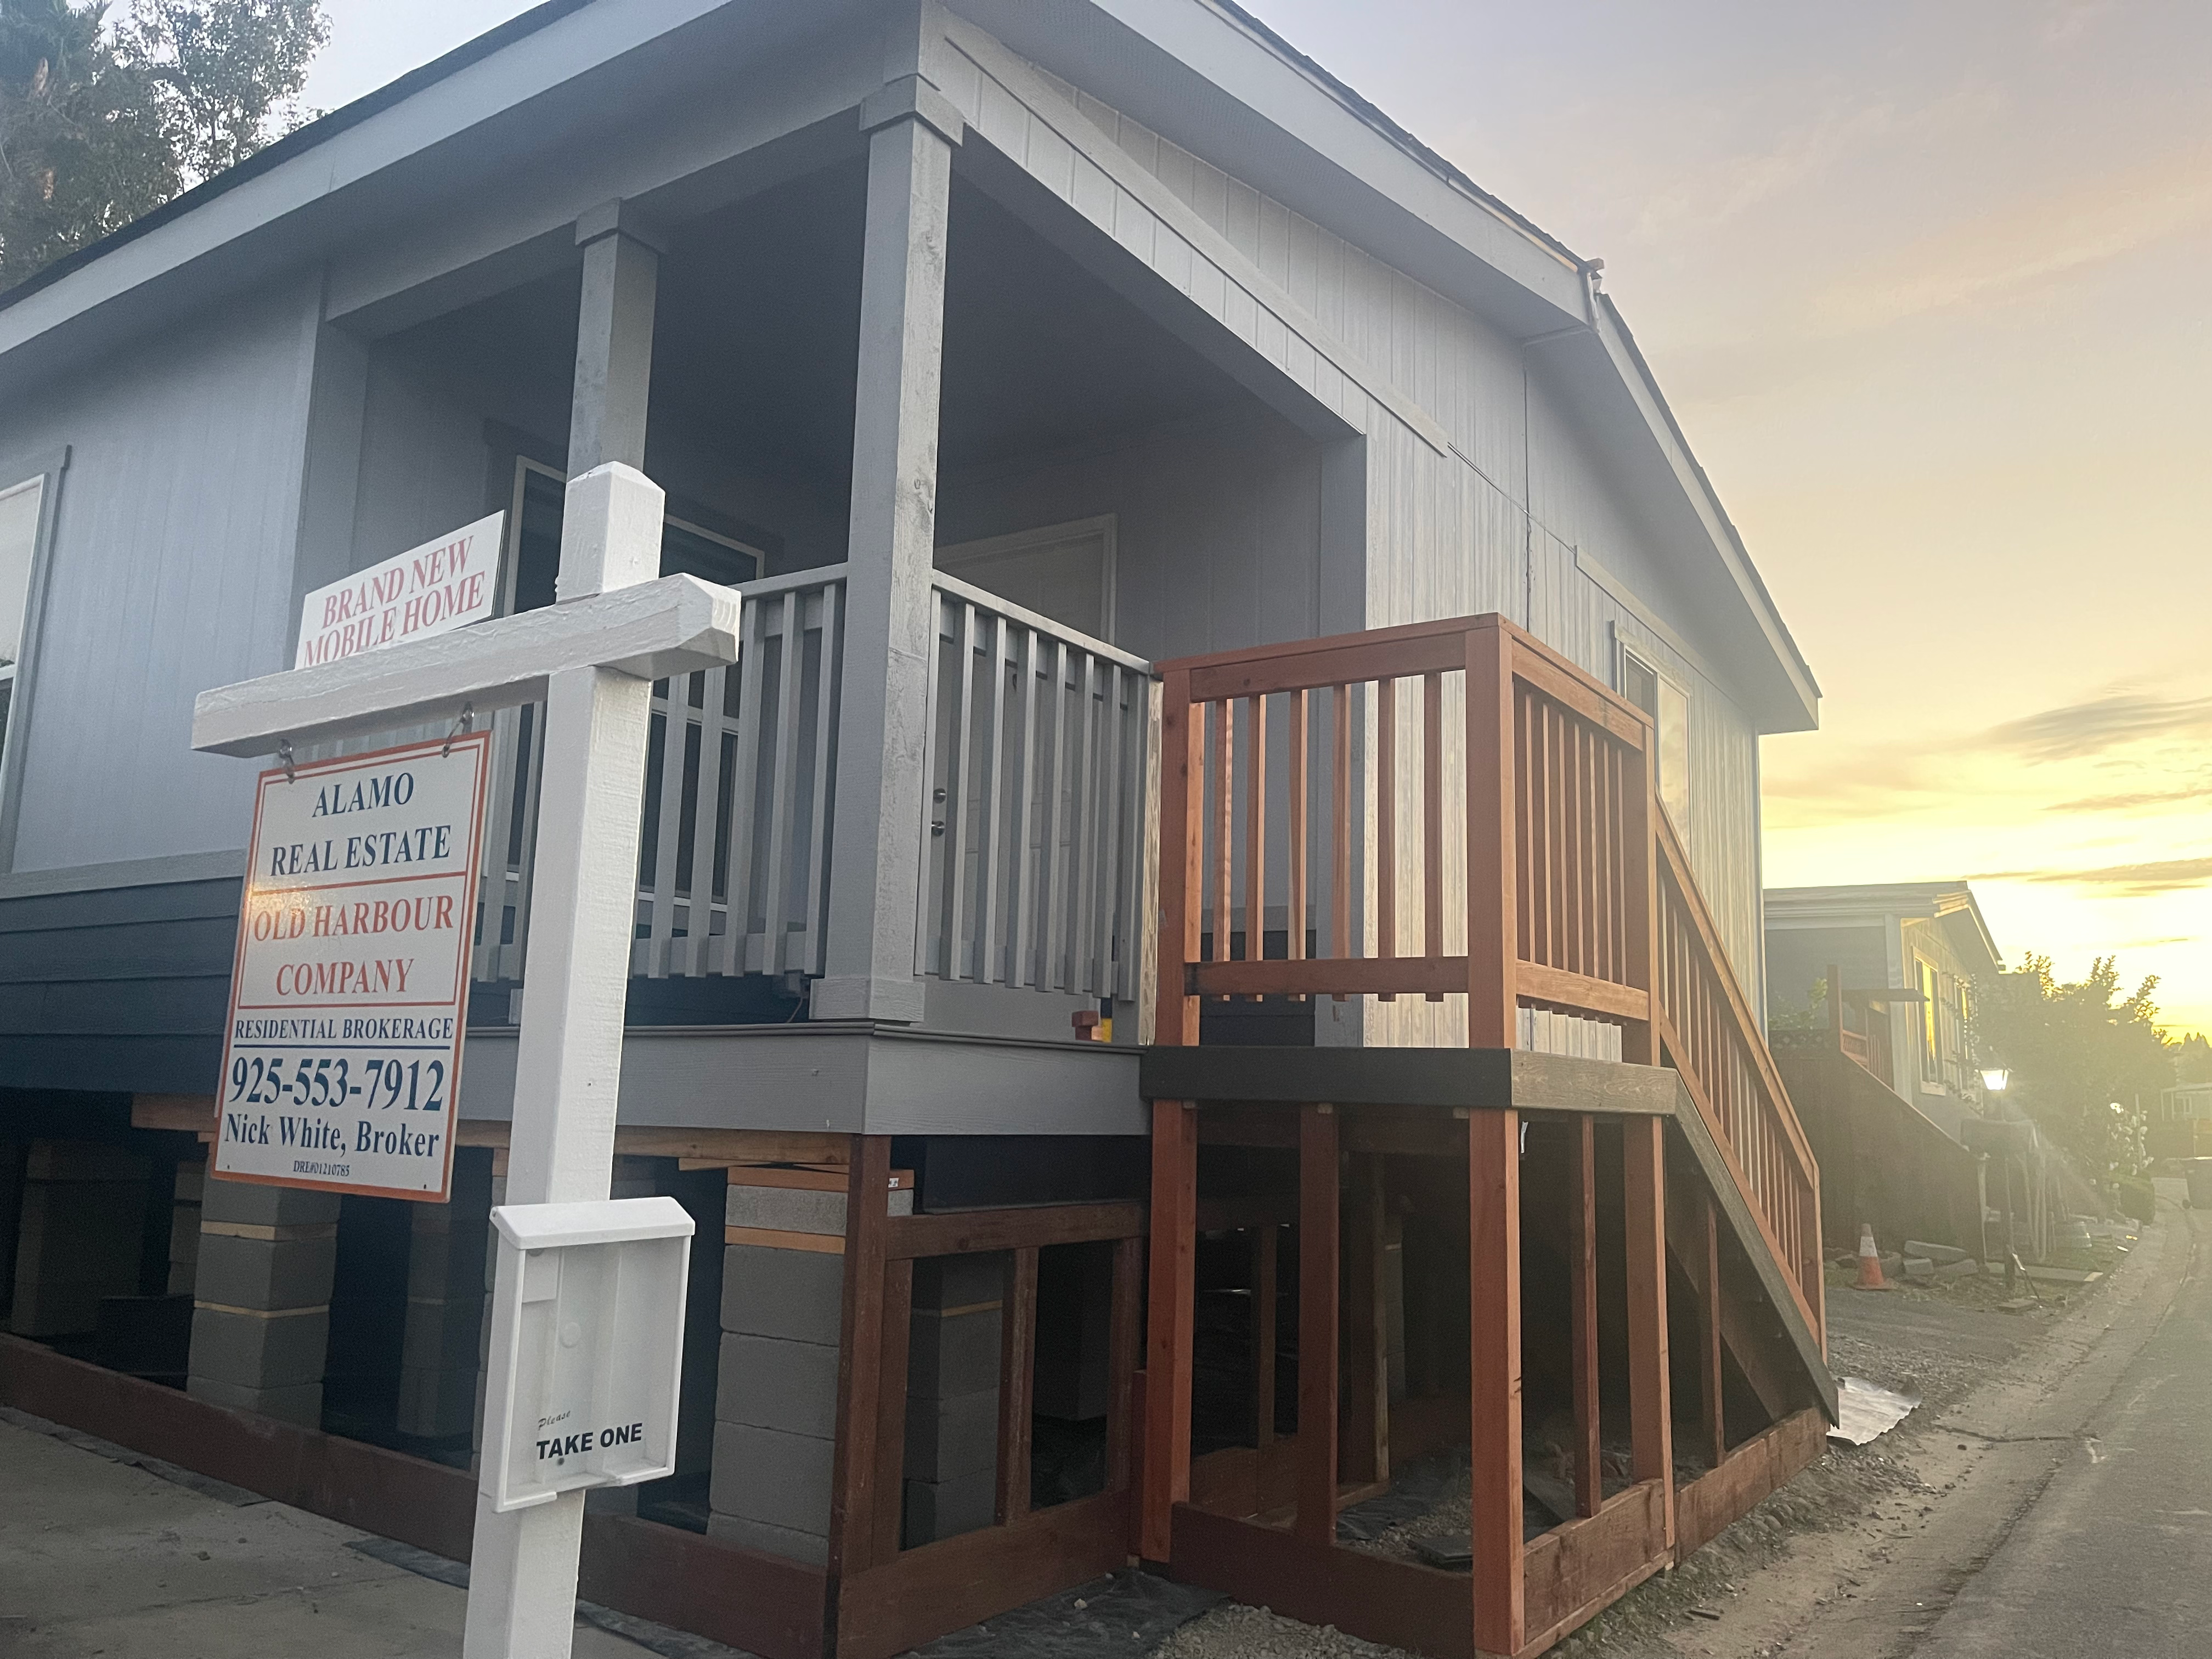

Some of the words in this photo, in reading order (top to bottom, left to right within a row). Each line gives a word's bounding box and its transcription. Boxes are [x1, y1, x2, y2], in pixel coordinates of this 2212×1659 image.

[321, 567, 404, 629] BRAND
[409, 535, 474, 594] NEW
[304, 606, 397, 667] MOBILE
[400, 571, 486, 636] HOME
[312, 772, 414, 817] ALAMO
[271, 840, 337, 877] REAL
[343, 825, 451, 868] ESTATE
[254, 906, 306, 941] OLD
[312, 895, 454, 937] HARBOUR
[276, 958, 414, 996] COMPANY
[234, 1019, 337, 1039] RESIDENTIAL
[343, 1018, 453, 1040] BROKERAGE
[228, 1057, 444, 1111] 925-553-7912
[224, 1113, 272, 1144] Nick
[279, 1116, 346, 1157] White,
[354, 1120, 439, 1156] Broker
[536, 1432, 593, 1459] TAKE
[600, 1423, 642, 1447] ONE
[538, 1410, 571, 1431] Please
